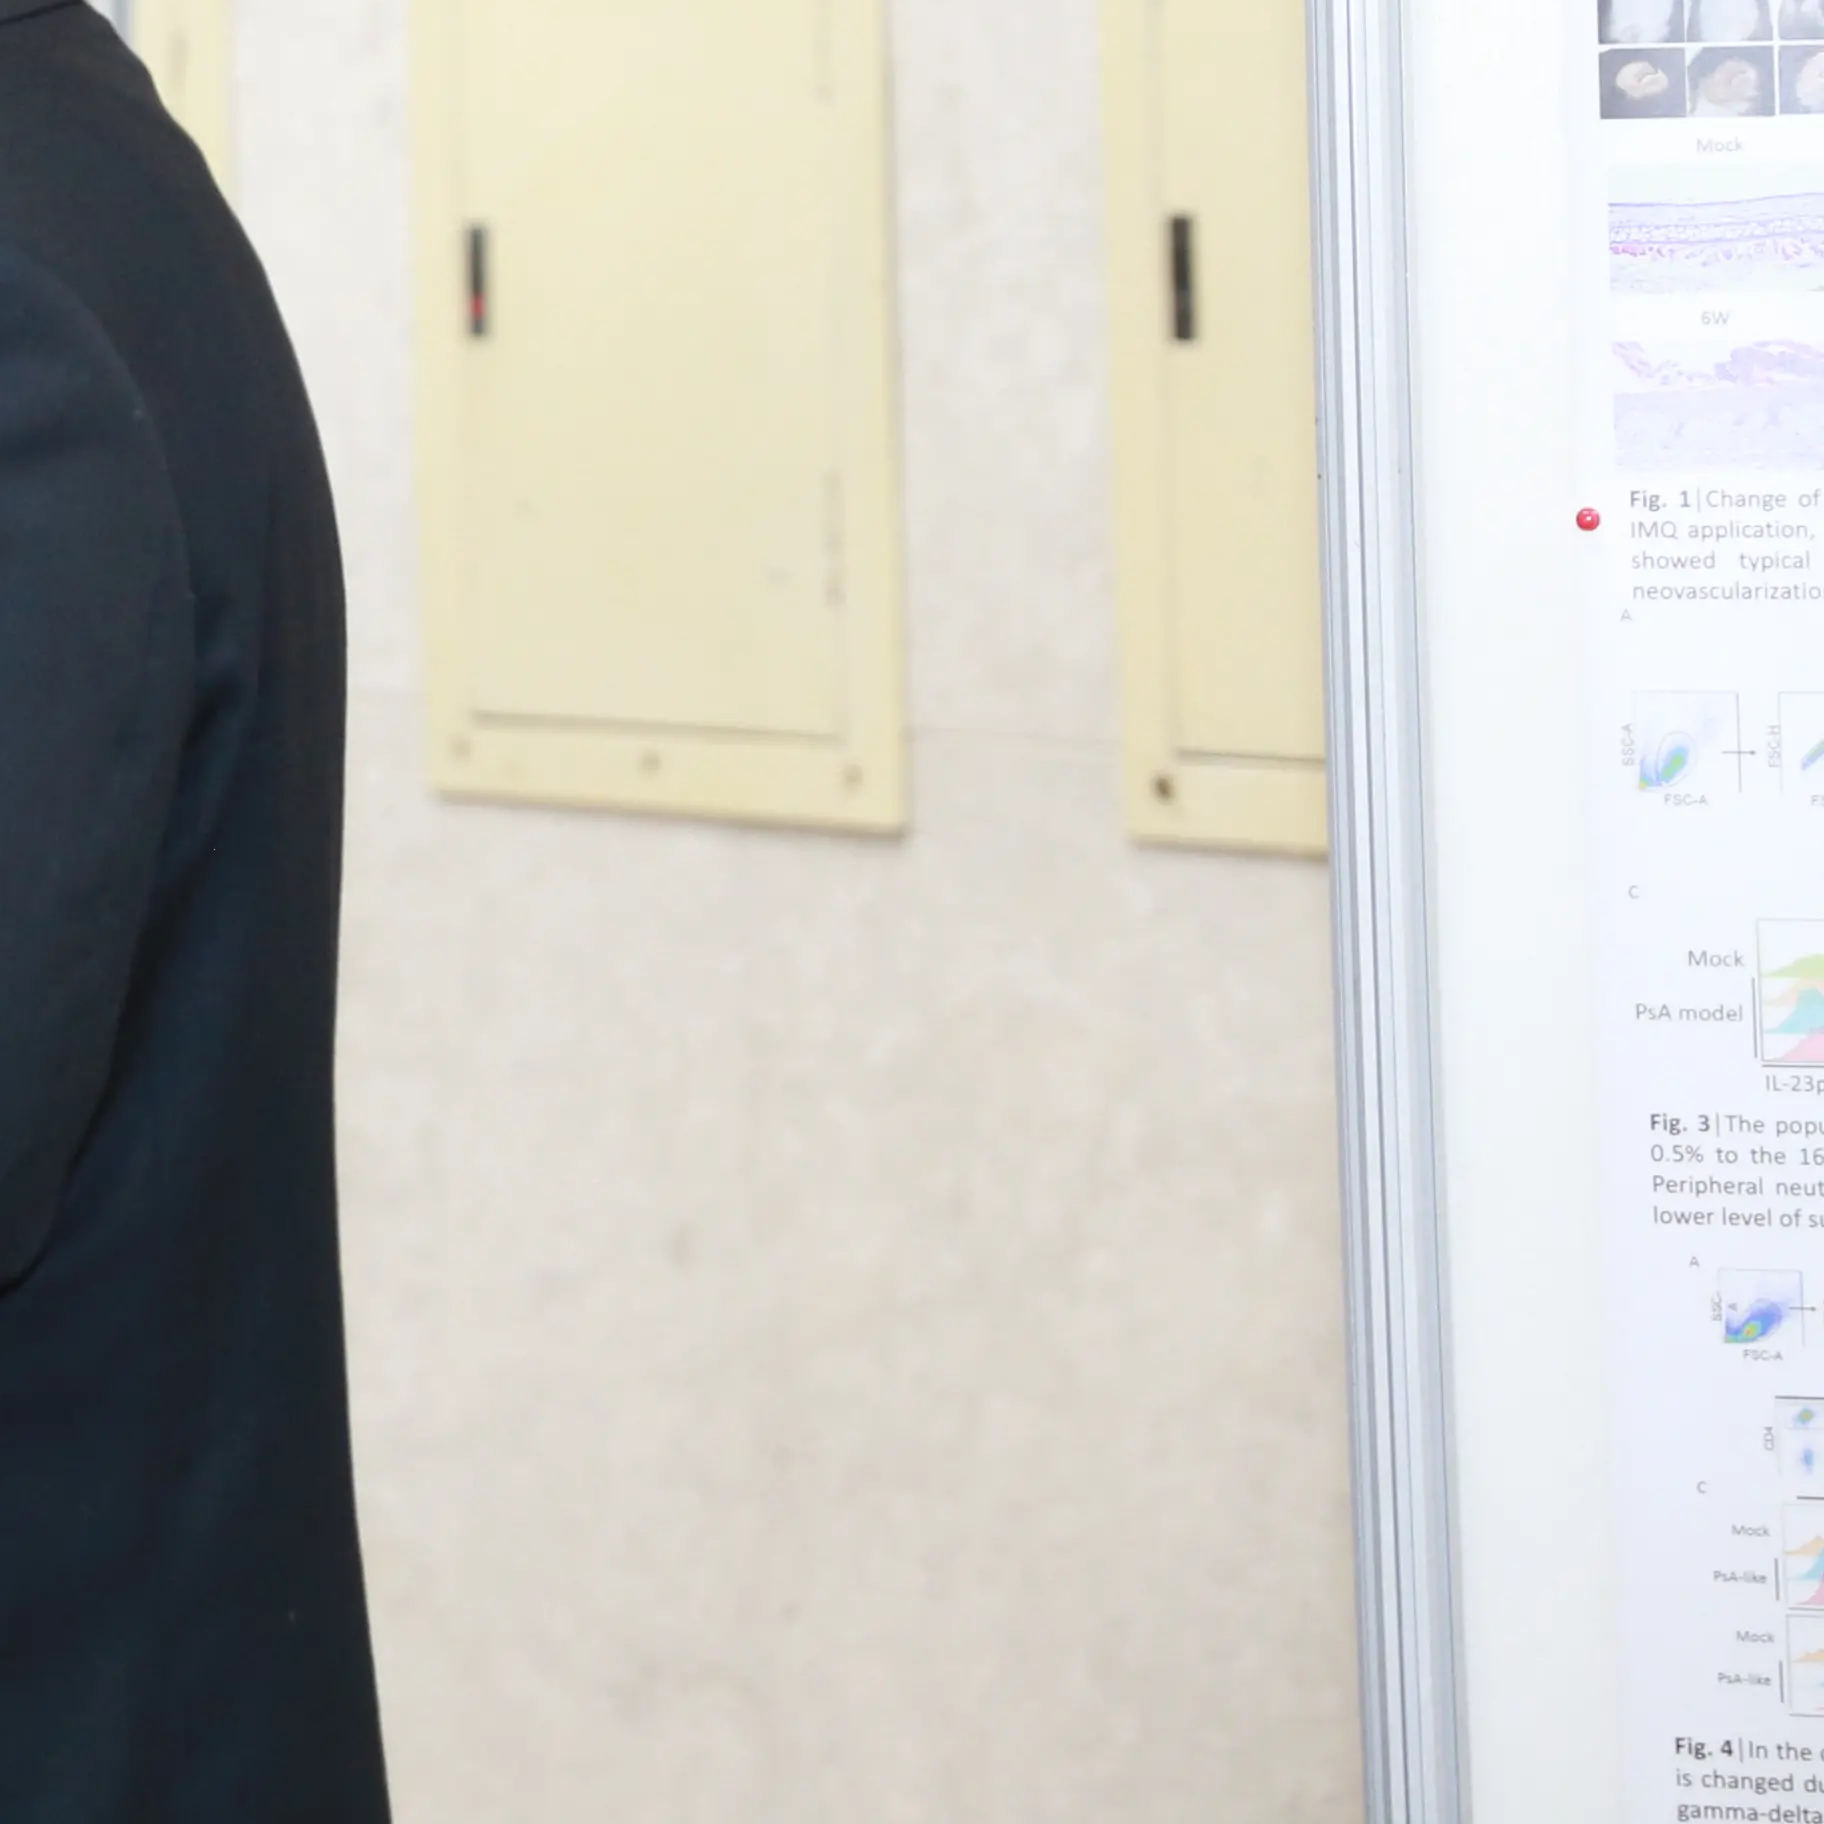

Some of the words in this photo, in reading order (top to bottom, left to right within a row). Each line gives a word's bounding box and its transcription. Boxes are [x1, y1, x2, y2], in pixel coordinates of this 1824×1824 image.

[1696, 137, 1744, 152] Mock
[1701, 310, 1730, 325] 6W
[1630, 490, 1666, 512] Fig.
[1798, 489, 1821, 507] of
[1631, 521, 1678, 540] IMQ
[1688, 521, 1815, 542] application,
[1632, 550, 1715, 569] showed
[1739, 550, 1810, 573] typical
[1632, 581, 1824, 600] neovascularizatio
[1620, 609, 1632, 622] A
[1688, 950, 1745, 967] Mock
[1636, 1003, 1672, 1021] PsA
[1679, 1004, 1743, 1021] model
[1650, 1113, 1687, 1136] Fig.
[1650, 1144, 1704, 1163] 0.5%
[1716, 1148, 1738, 1164] to
[1750, 1146, 1786, 1165] the
[1653, 1175, 1763, 1198] Peripheral
[1654, 1206, 1714, 1225] lower
[1722, 1207, 1772, 1227] level
[1779, 1208, 1801, 1227] of
[1689, 1256, 1700, 1268] A
[1731, 1524, 1770, 1537] Mock
[1736, 1630, 1775, 1643] Mock
[1675, 1737, 1712, 1760] Fig.
[1776, 1742, 1812, 1761] the
[1676, 1768, 1693, 1787] is
[1701, 1769, 1794, 1795] changed
